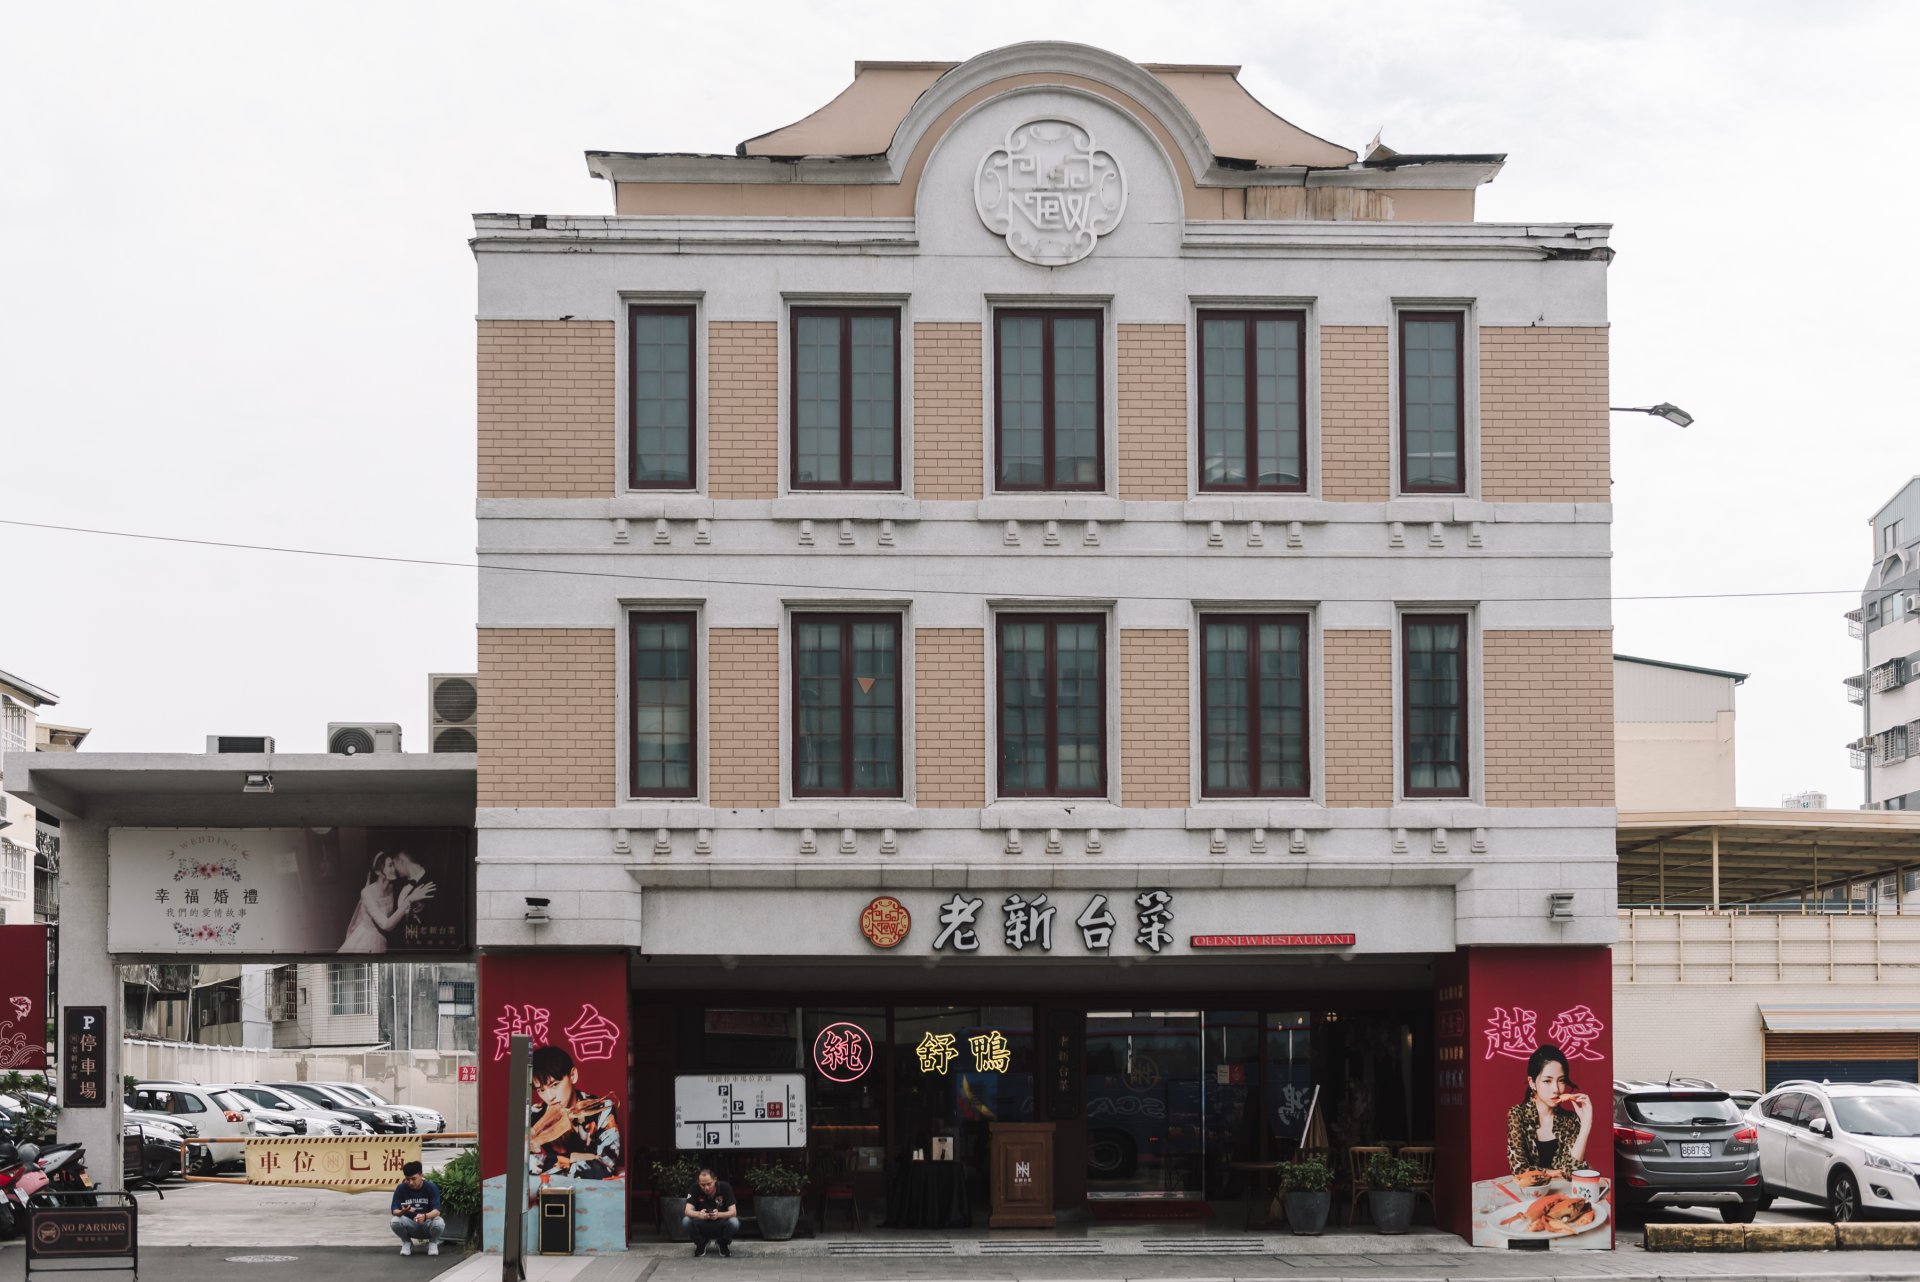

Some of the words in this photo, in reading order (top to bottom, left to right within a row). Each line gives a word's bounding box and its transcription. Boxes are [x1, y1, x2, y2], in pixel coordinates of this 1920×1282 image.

[179, 835, 239, 852] WEDDING
[154, 888, 259, 905] 幸福婚禮
[166, 907, 248, 918] 我們的愛情故事
[932, 889, 1175, 953] 老新台菜
[1262, 934, 1353, 946] RESTAURANT
[83, 1015, 95, 1030] P
[1483, 1004, 1606, 1061] 越愛
[820, 1030, 864, 1071] 純
[915, 1030, 1012, 1075] 舒鴨
[79, 1033, 98, 1100] 停車場
[61, 1223, 75, 1232] NO
[78, 1223, 126, 1232] PARKING
